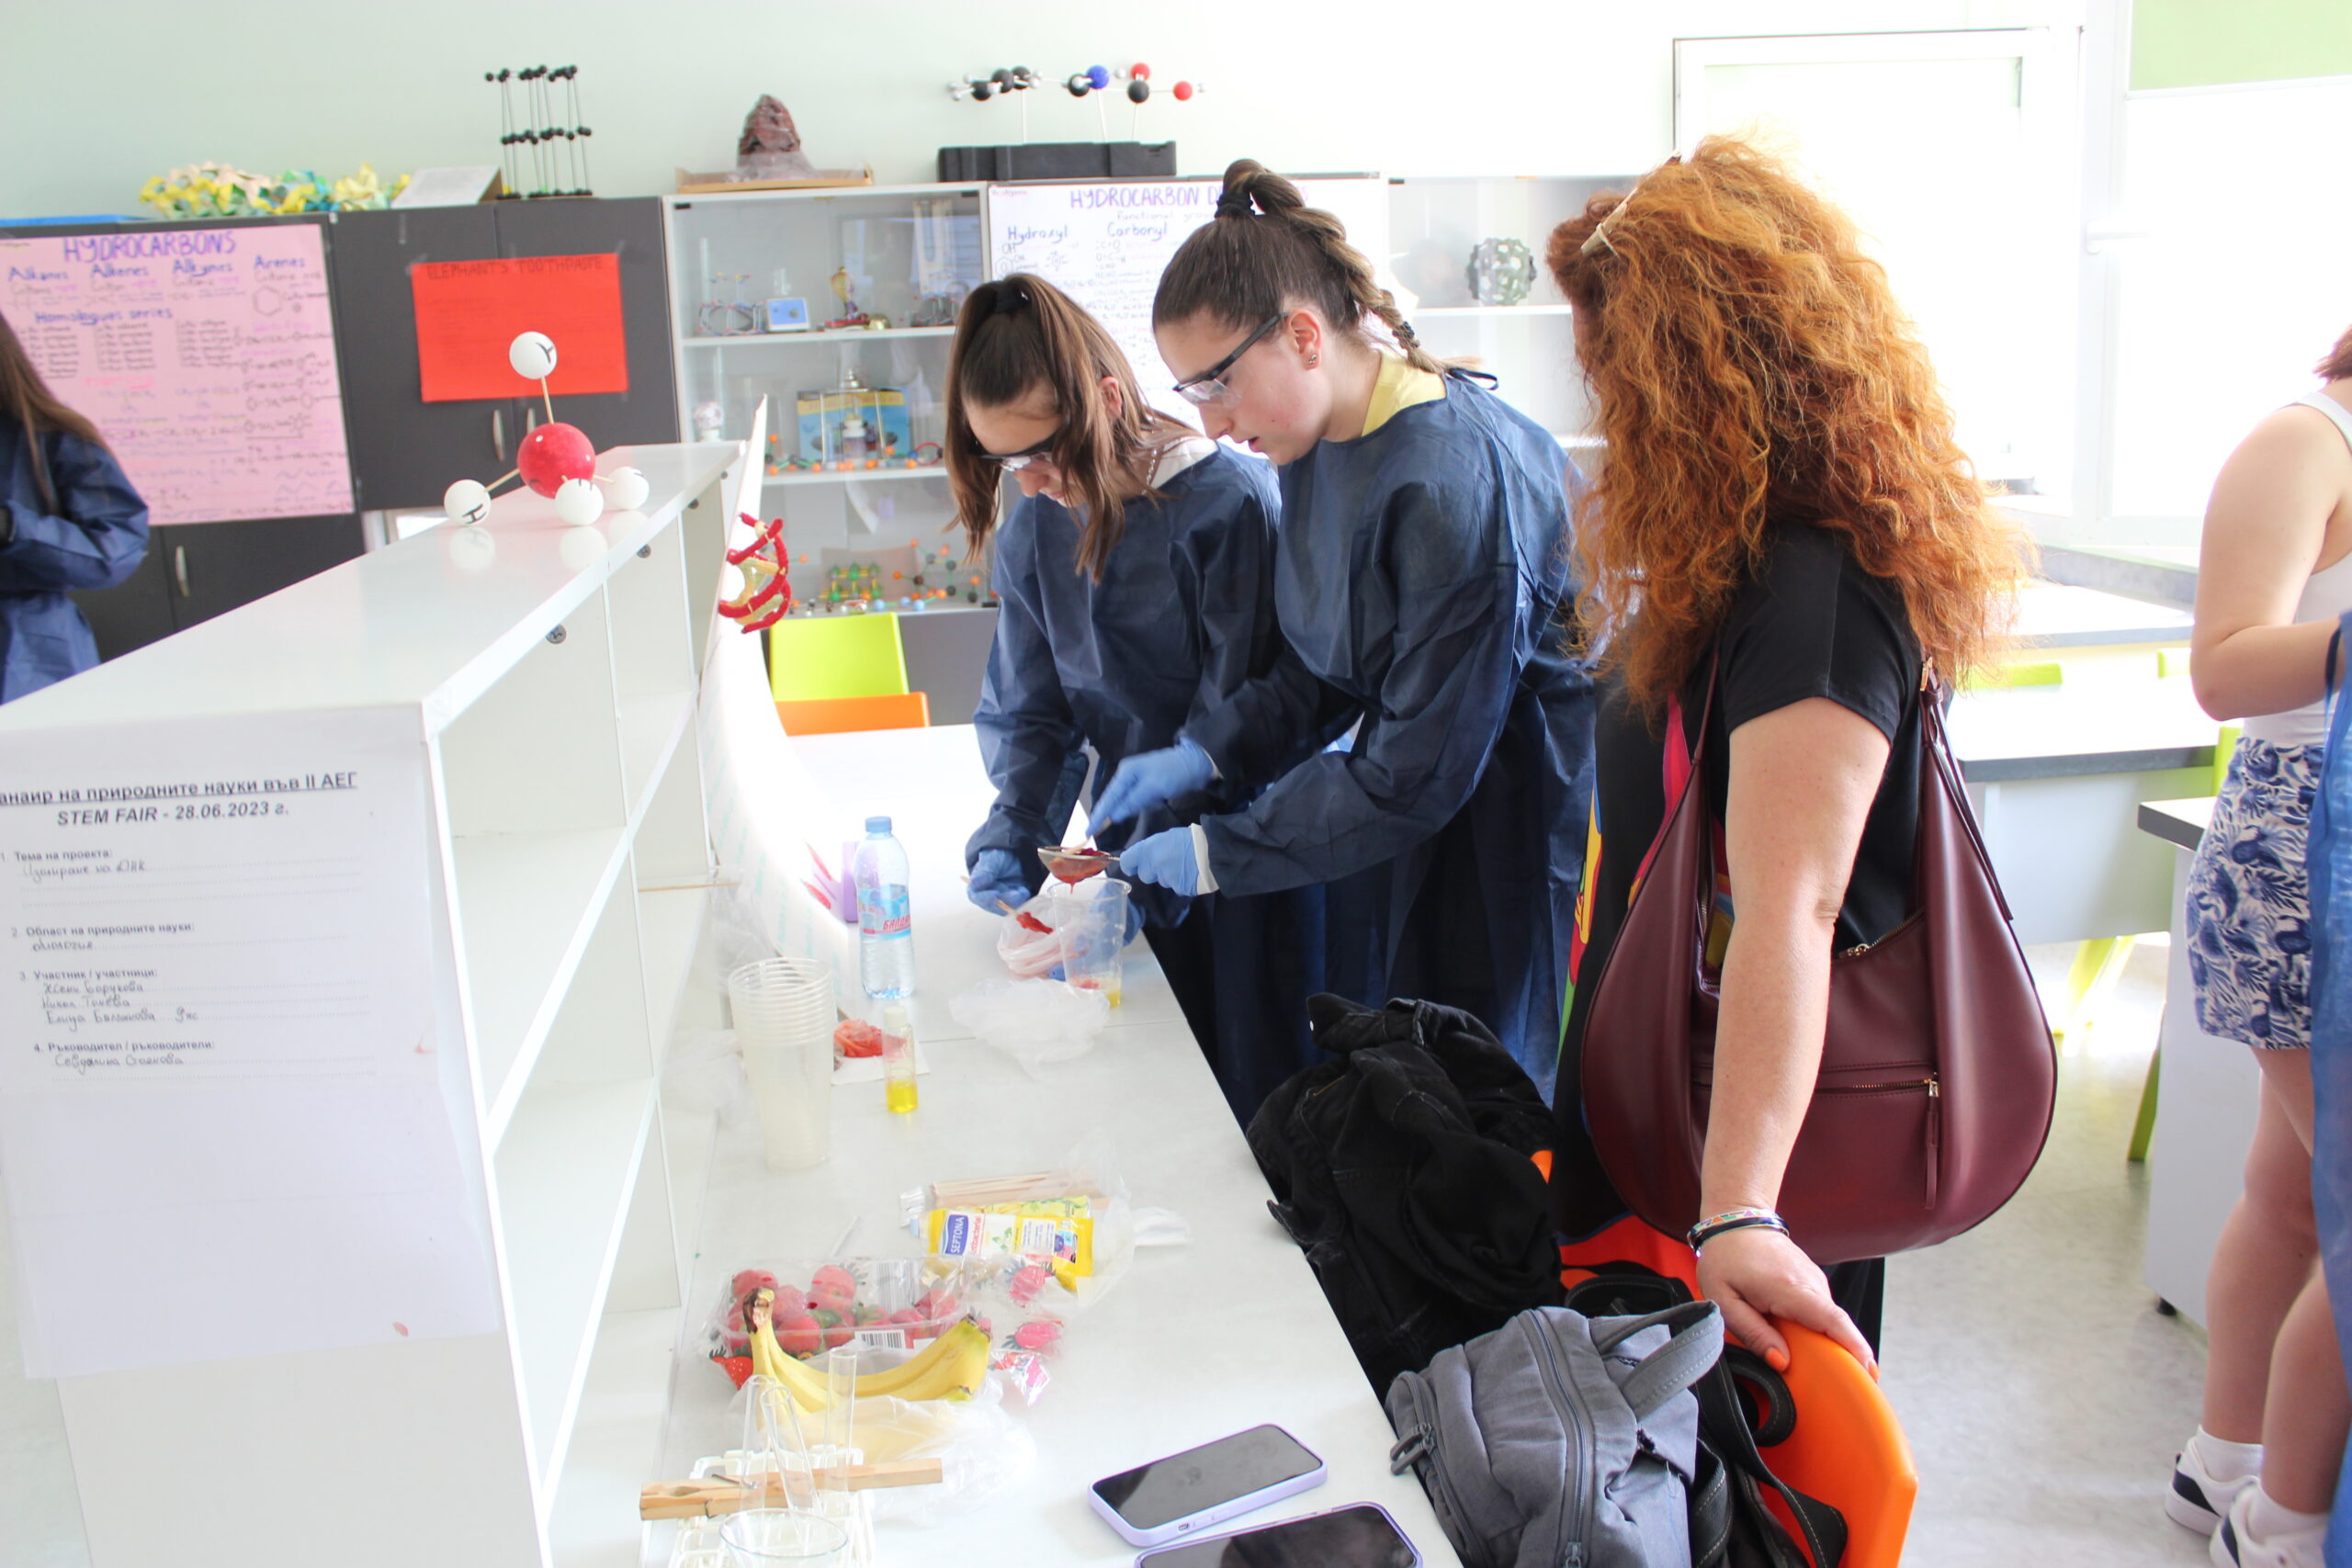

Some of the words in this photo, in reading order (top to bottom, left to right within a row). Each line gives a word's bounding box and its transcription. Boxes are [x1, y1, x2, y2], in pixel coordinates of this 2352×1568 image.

[1070, 186, 1200, 209] HYDROCARBON
[1007, 225, 1069, 245] Hydroxyl
[1106, 221, 1169, 242] Carbonyl
[63, 231, 236, 263] HYDROCARBONS
[253, 254, 306, 269] Arenes
[59, 789, 81, 802] на
[87, 783, 198, 802] природните
[204, 779, 258, 796] науки
[264, 778, 300, 793] във
[322, 772, 358, 788] АЕГ
[57, 808, 109, 826] STEM
[115, 807, 158, 823] FAIR
[175, 801, 269, 820] 28.06.2023
[15, 851, 42, 862] Тема
[46, 852, 60, 861] на
[26, 925, 67, 937] Област
[71, 926, 85, 936] на
[87, 924, 155, 937] природните
[33, 969, 87, 980] Участник
[48, 1042, 123, 1054] Ръководител
[950, 1215, 966, 1254] SEPTONA
